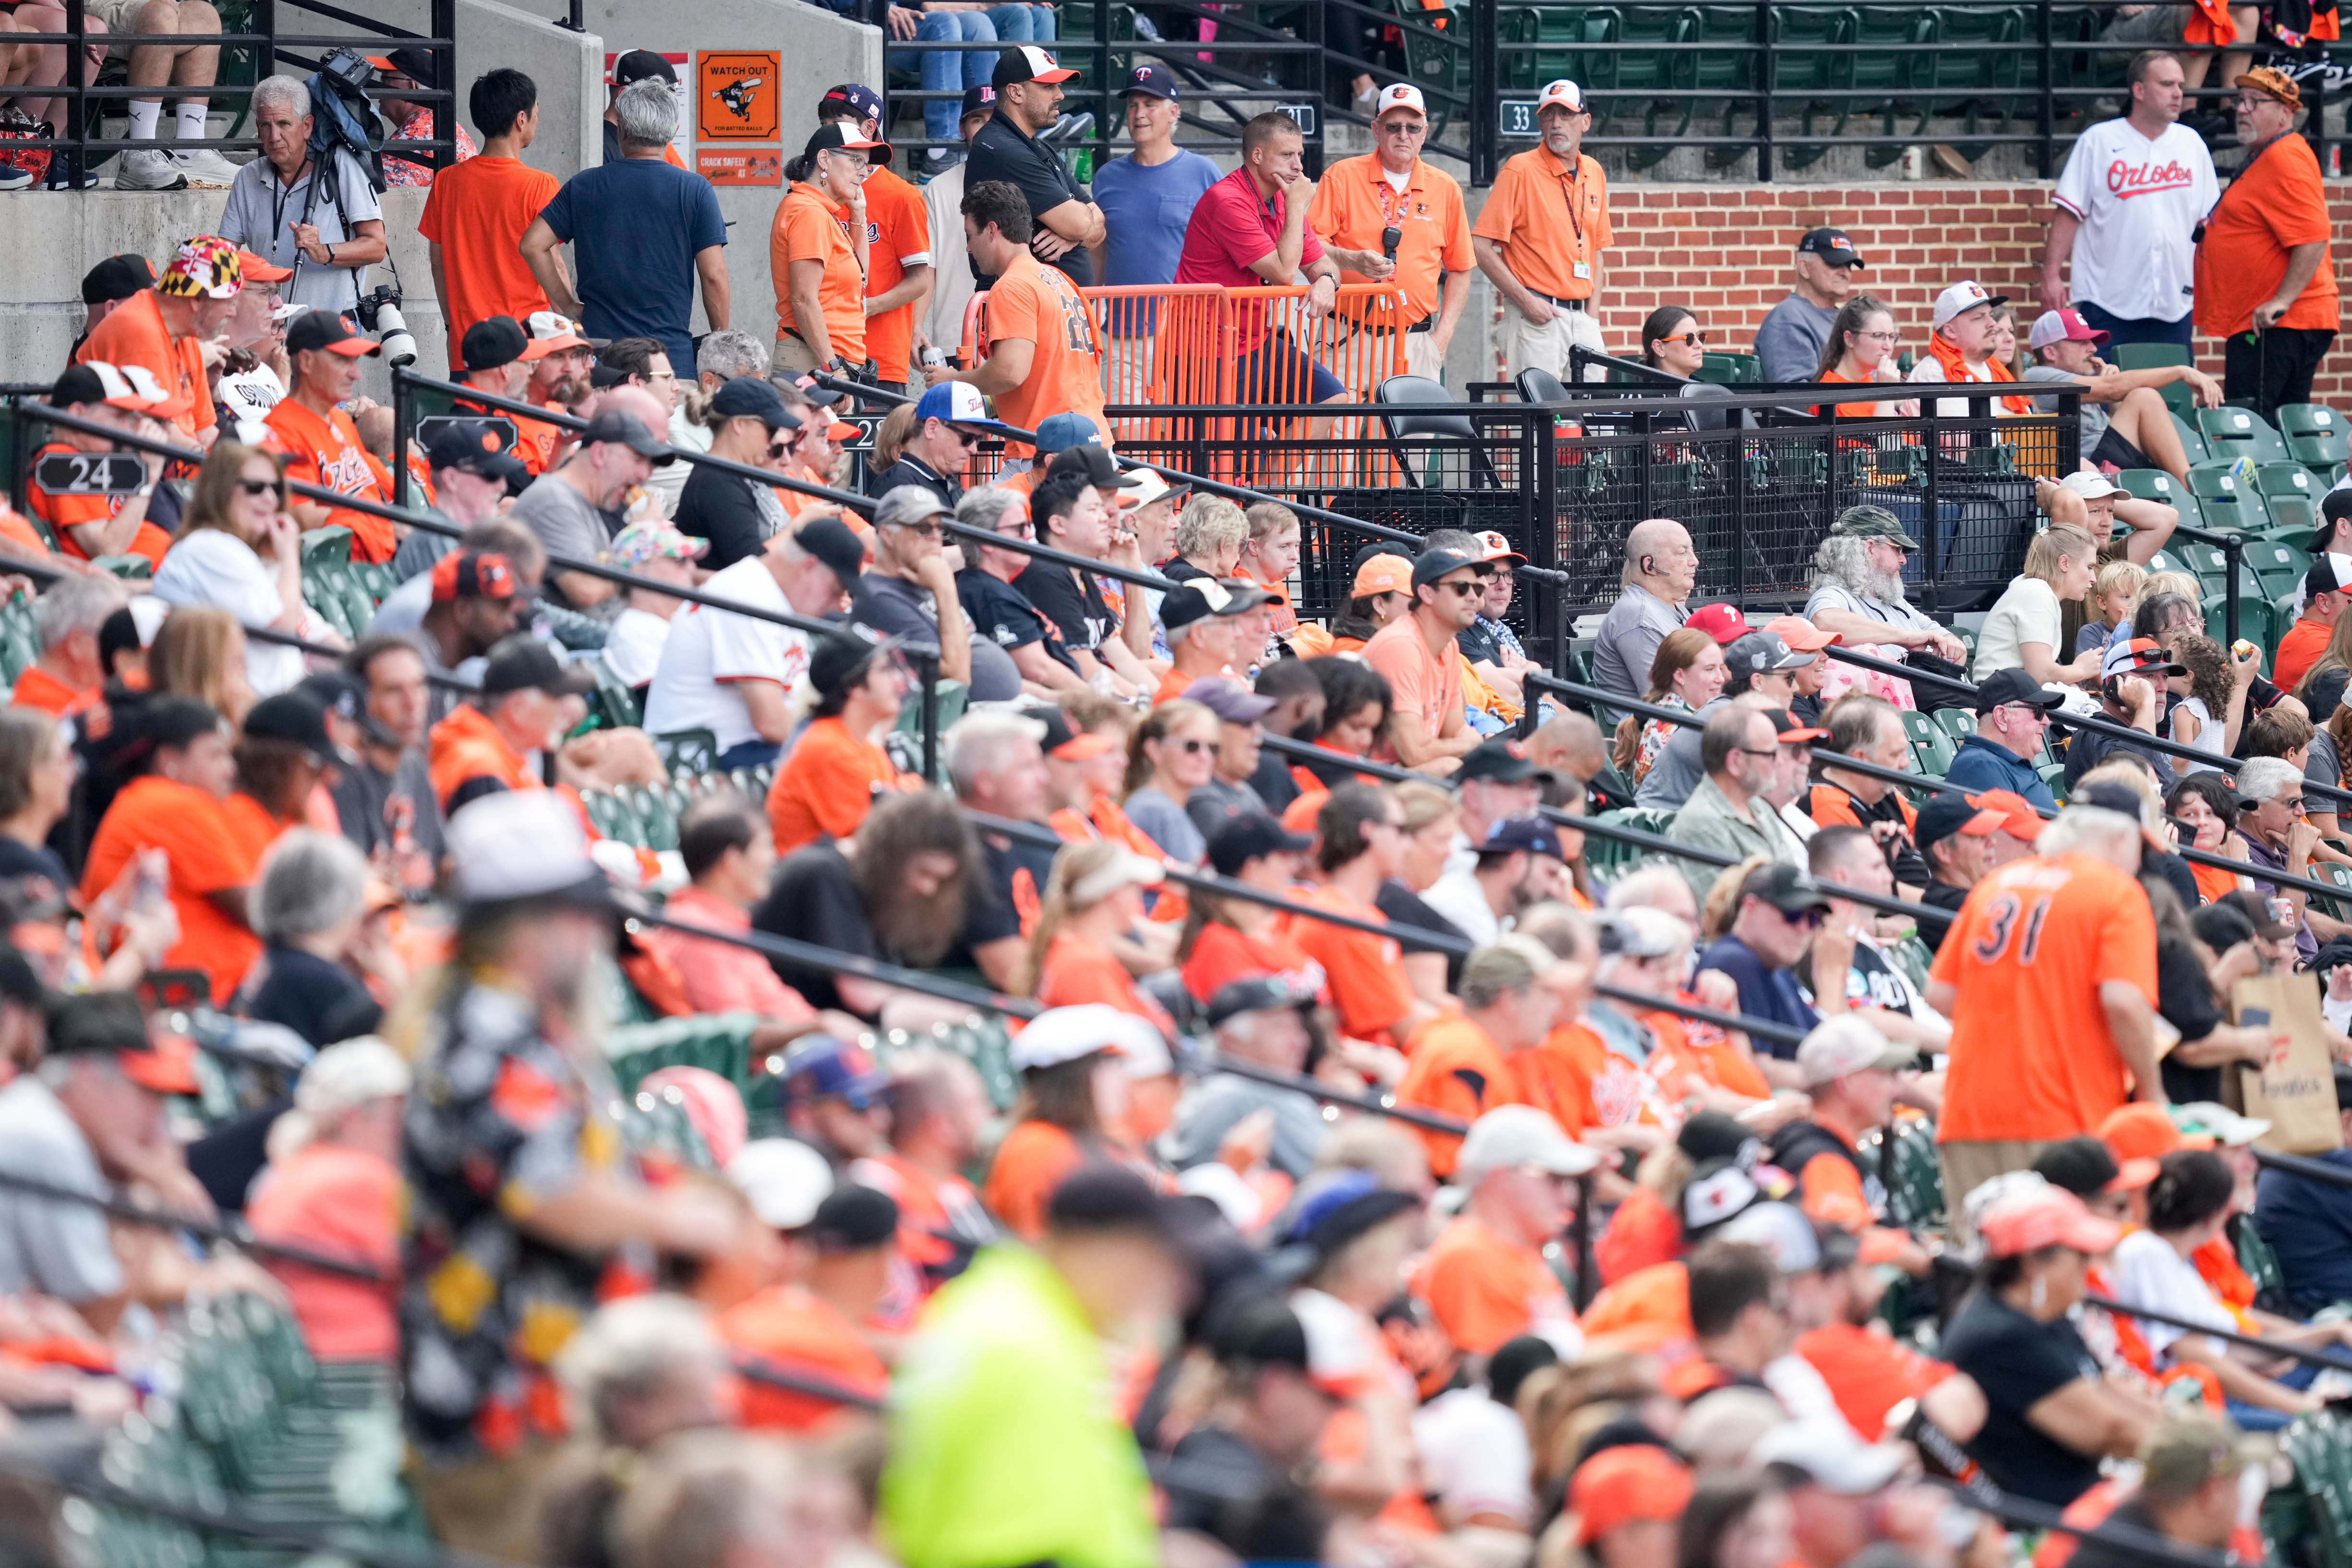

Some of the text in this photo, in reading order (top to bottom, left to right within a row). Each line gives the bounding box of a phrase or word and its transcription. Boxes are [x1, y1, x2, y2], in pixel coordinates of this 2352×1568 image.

[711, 66, 769, 76] WATCH OUT
[1513, 106, 1530, 131] 33
[700, 157, 746, 167] CRACK SAFELY
[738, 169, 746, 178] AT
[2108, 159, 2192, 192] Orioles
[857, 420, 884, 446] 2
[69, 457, 113, 490] 24
[1724, 606, 1736, 622] P
[1971, 892, 2051, 967] 31
